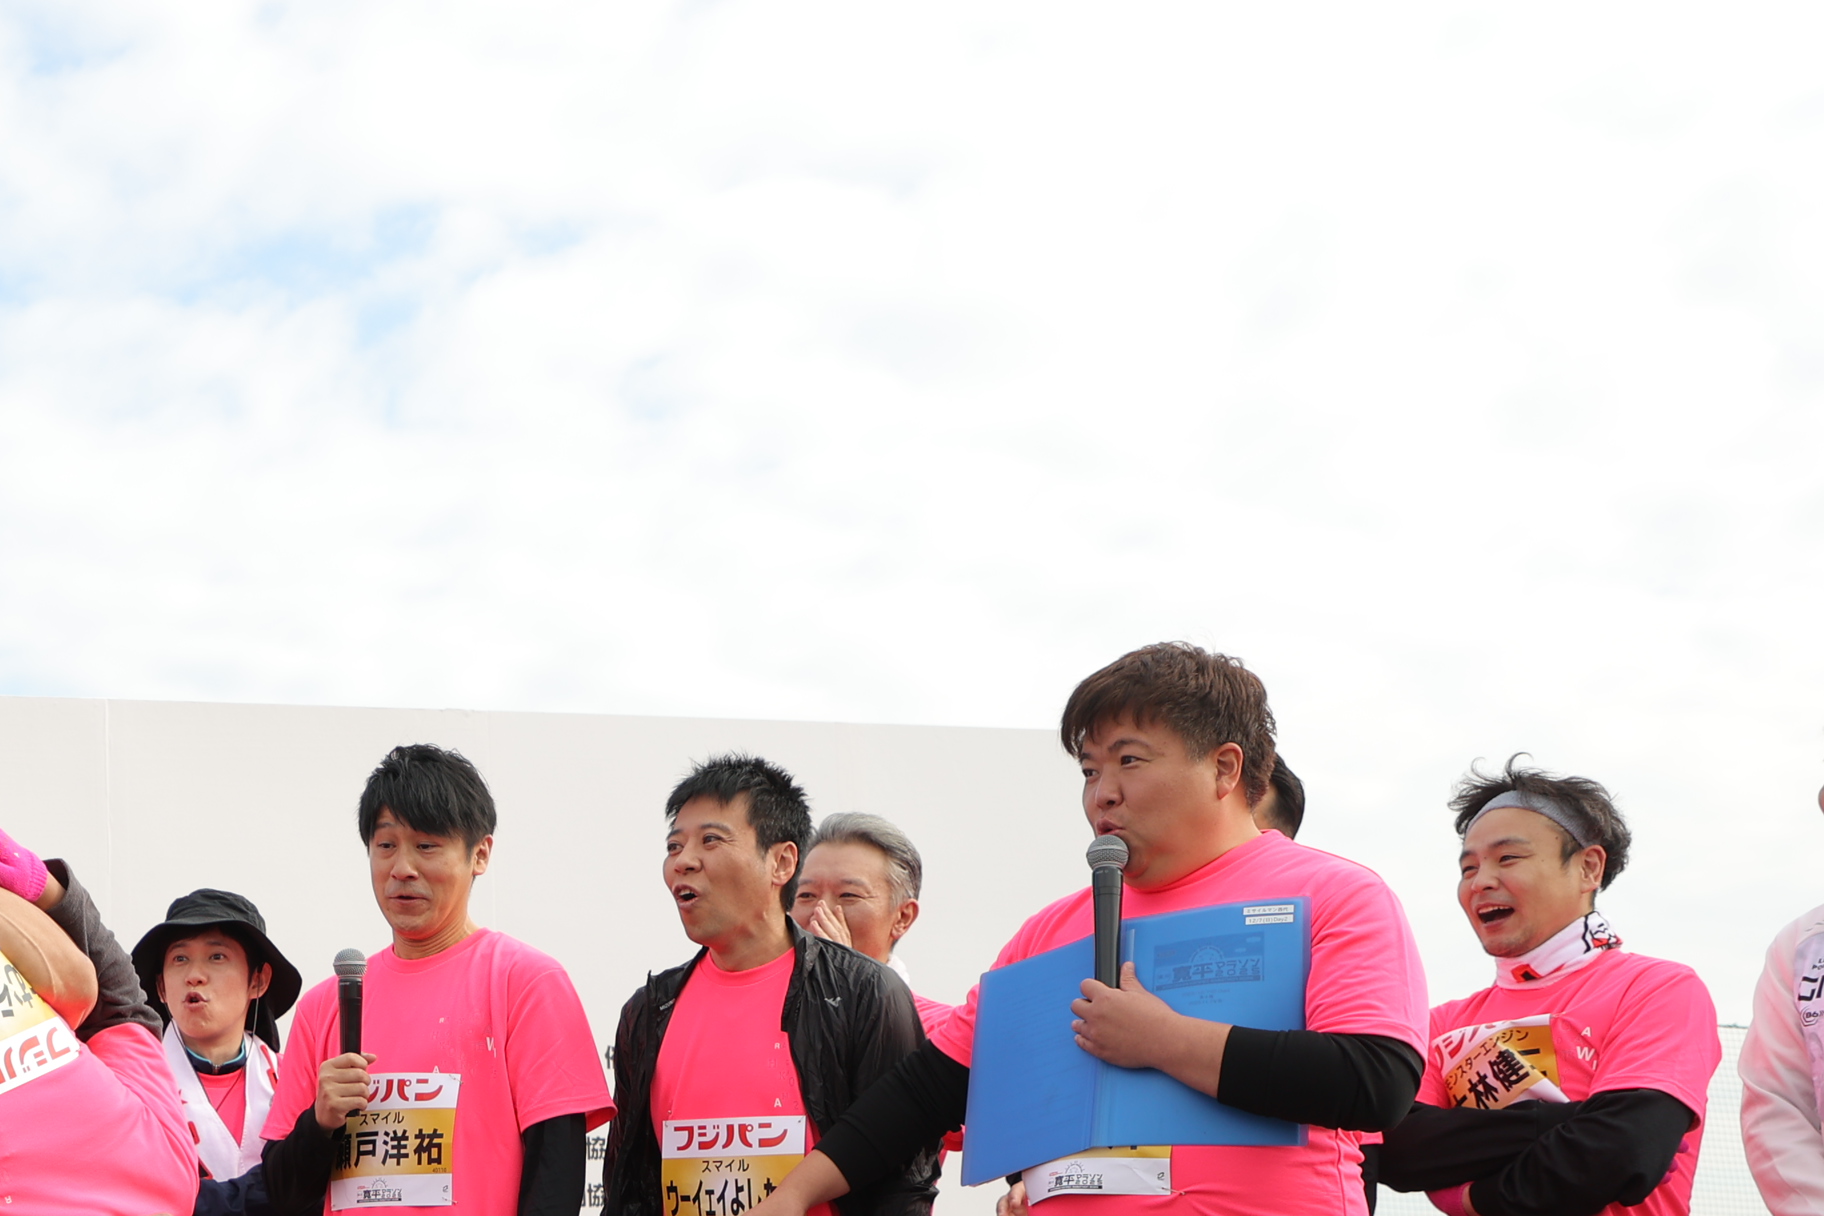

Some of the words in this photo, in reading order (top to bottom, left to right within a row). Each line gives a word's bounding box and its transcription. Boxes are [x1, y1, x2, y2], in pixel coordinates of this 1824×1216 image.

[359, 1111, 405, 1127] スマイル
[674, 1122, 788, 1151] フジパン
[702, 1158, 750, 1173] スマイル
